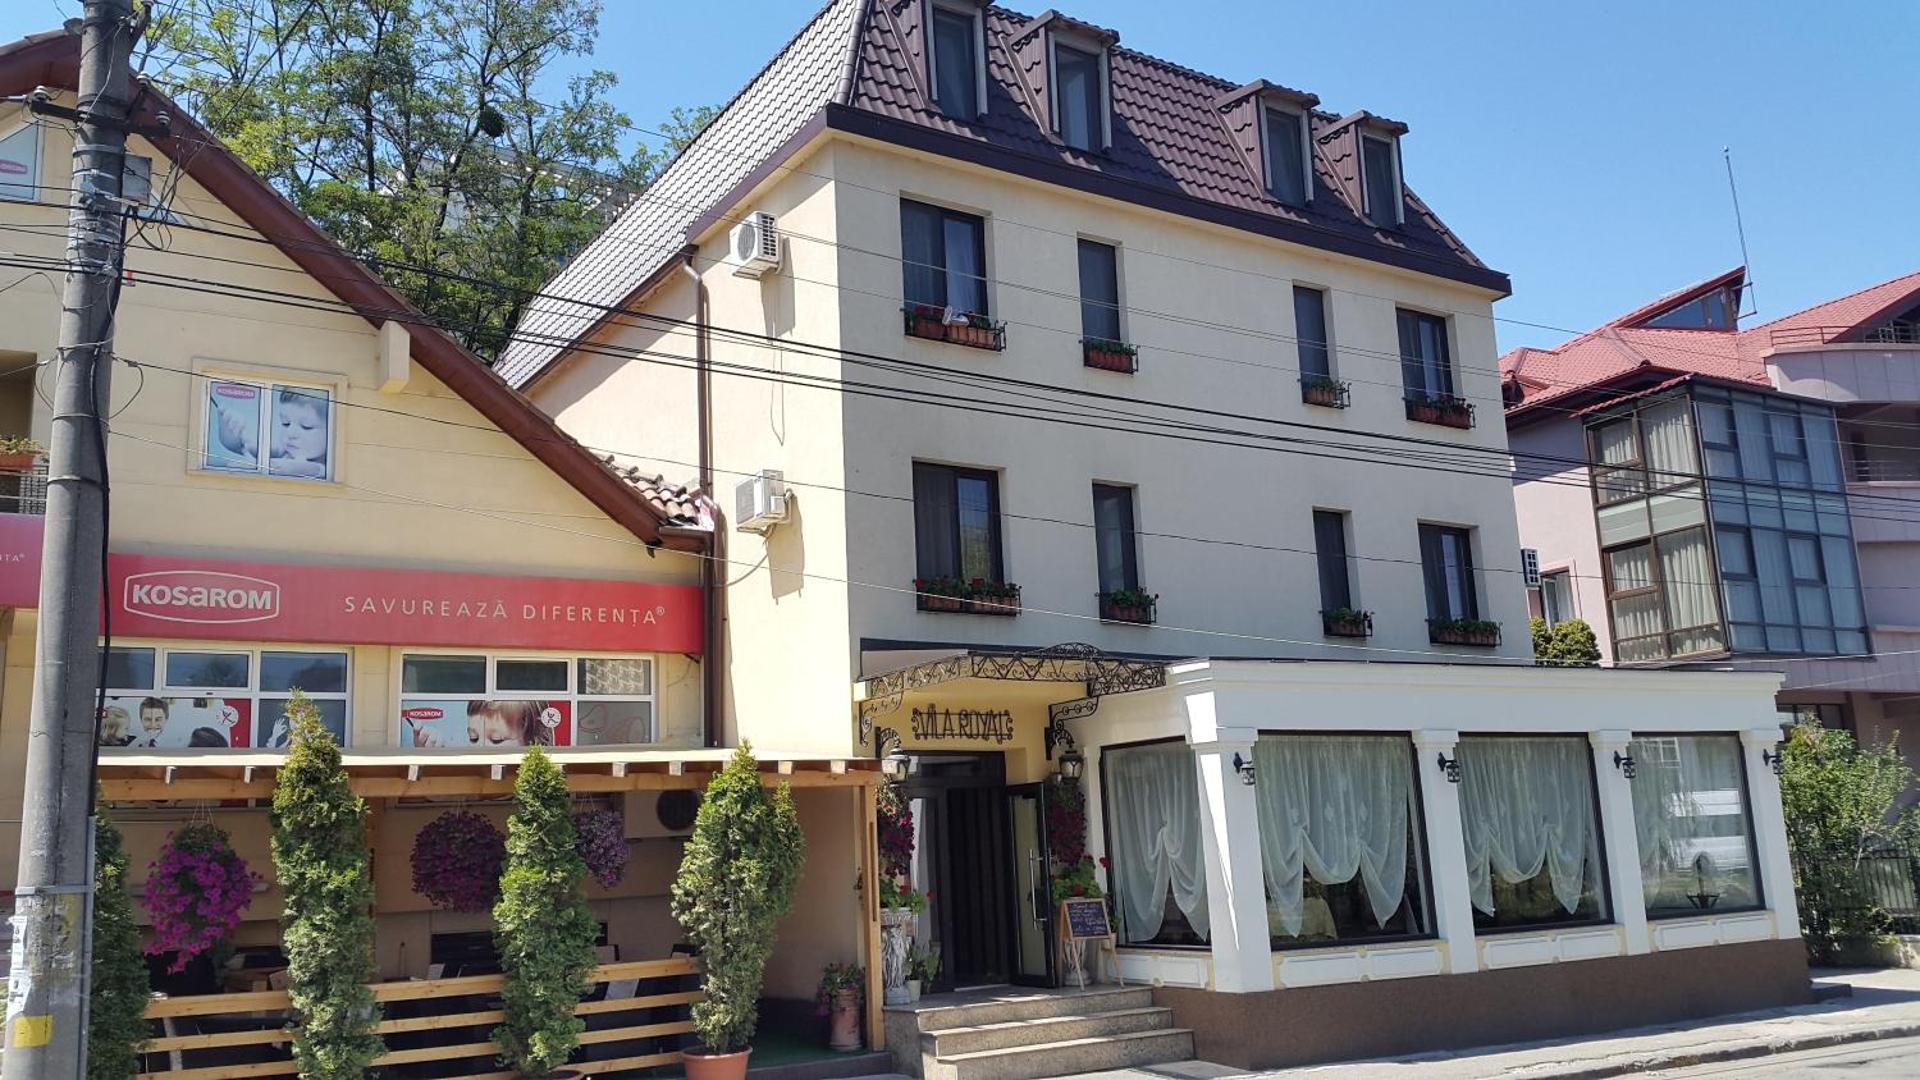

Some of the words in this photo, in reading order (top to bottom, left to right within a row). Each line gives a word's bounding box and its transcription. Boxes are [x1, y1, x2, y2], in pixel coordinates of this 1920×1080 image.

[344, 596, 508, 618] SAVUREAZĂ
[918, 703, 955, 741] VILA
[958, 708, 1008, 745] ROYAL
